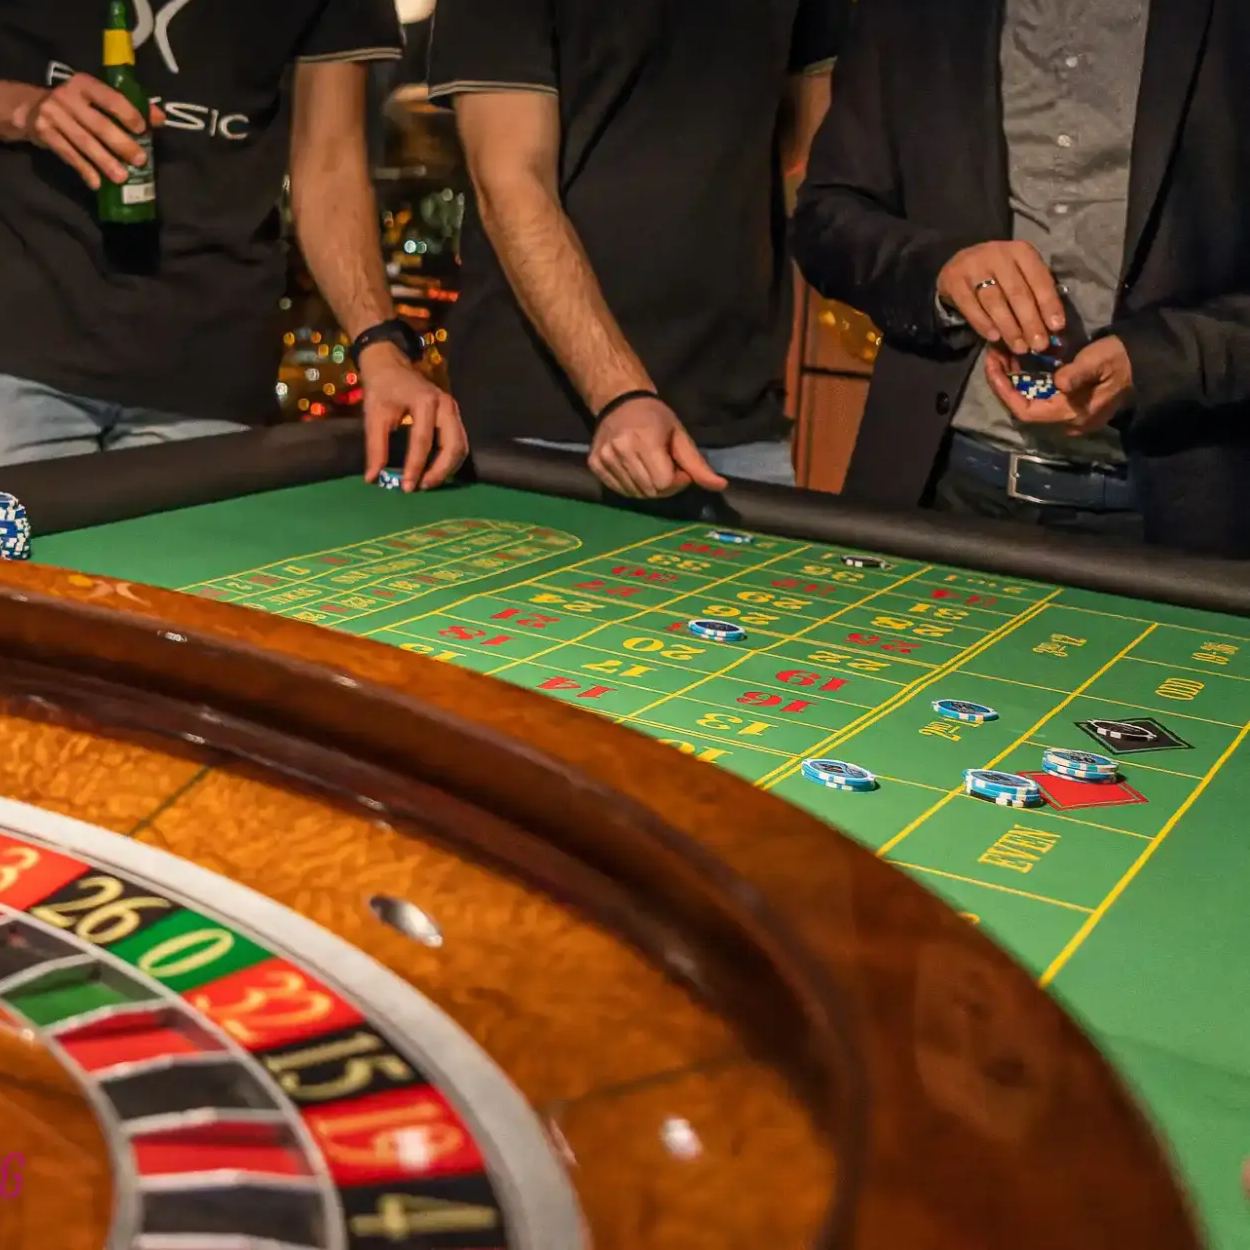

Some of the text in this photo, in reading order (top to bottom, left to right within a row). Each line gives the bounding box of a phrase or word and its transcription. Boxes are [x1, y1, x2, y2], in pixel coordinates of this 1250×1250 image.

[490, 607, 562, 629] 21
[701, 604, 781, 626] 26
[437, 625, 516, 647] 18
[622, 637, 707, 661] 20
[806, 650, 892, 672] 22
[581, 659, 659, 678] 17
[775, 669, 851, 692] 19
[536, 675, 619, 700] 14
[1154, 677, 1205, 701] ODD
[736, 691, 819, 714] 16
[696, 712, 779, 737] 13
[977, 823, 1062, 874] EVEN
[29, 875, 171, 946] 26
[136, 928, 236, 978] 0
[194, 969, 333, 1042] 32
[262, 1030, 412, 1100] 15
[351, 1192, 497, 1241] 4
